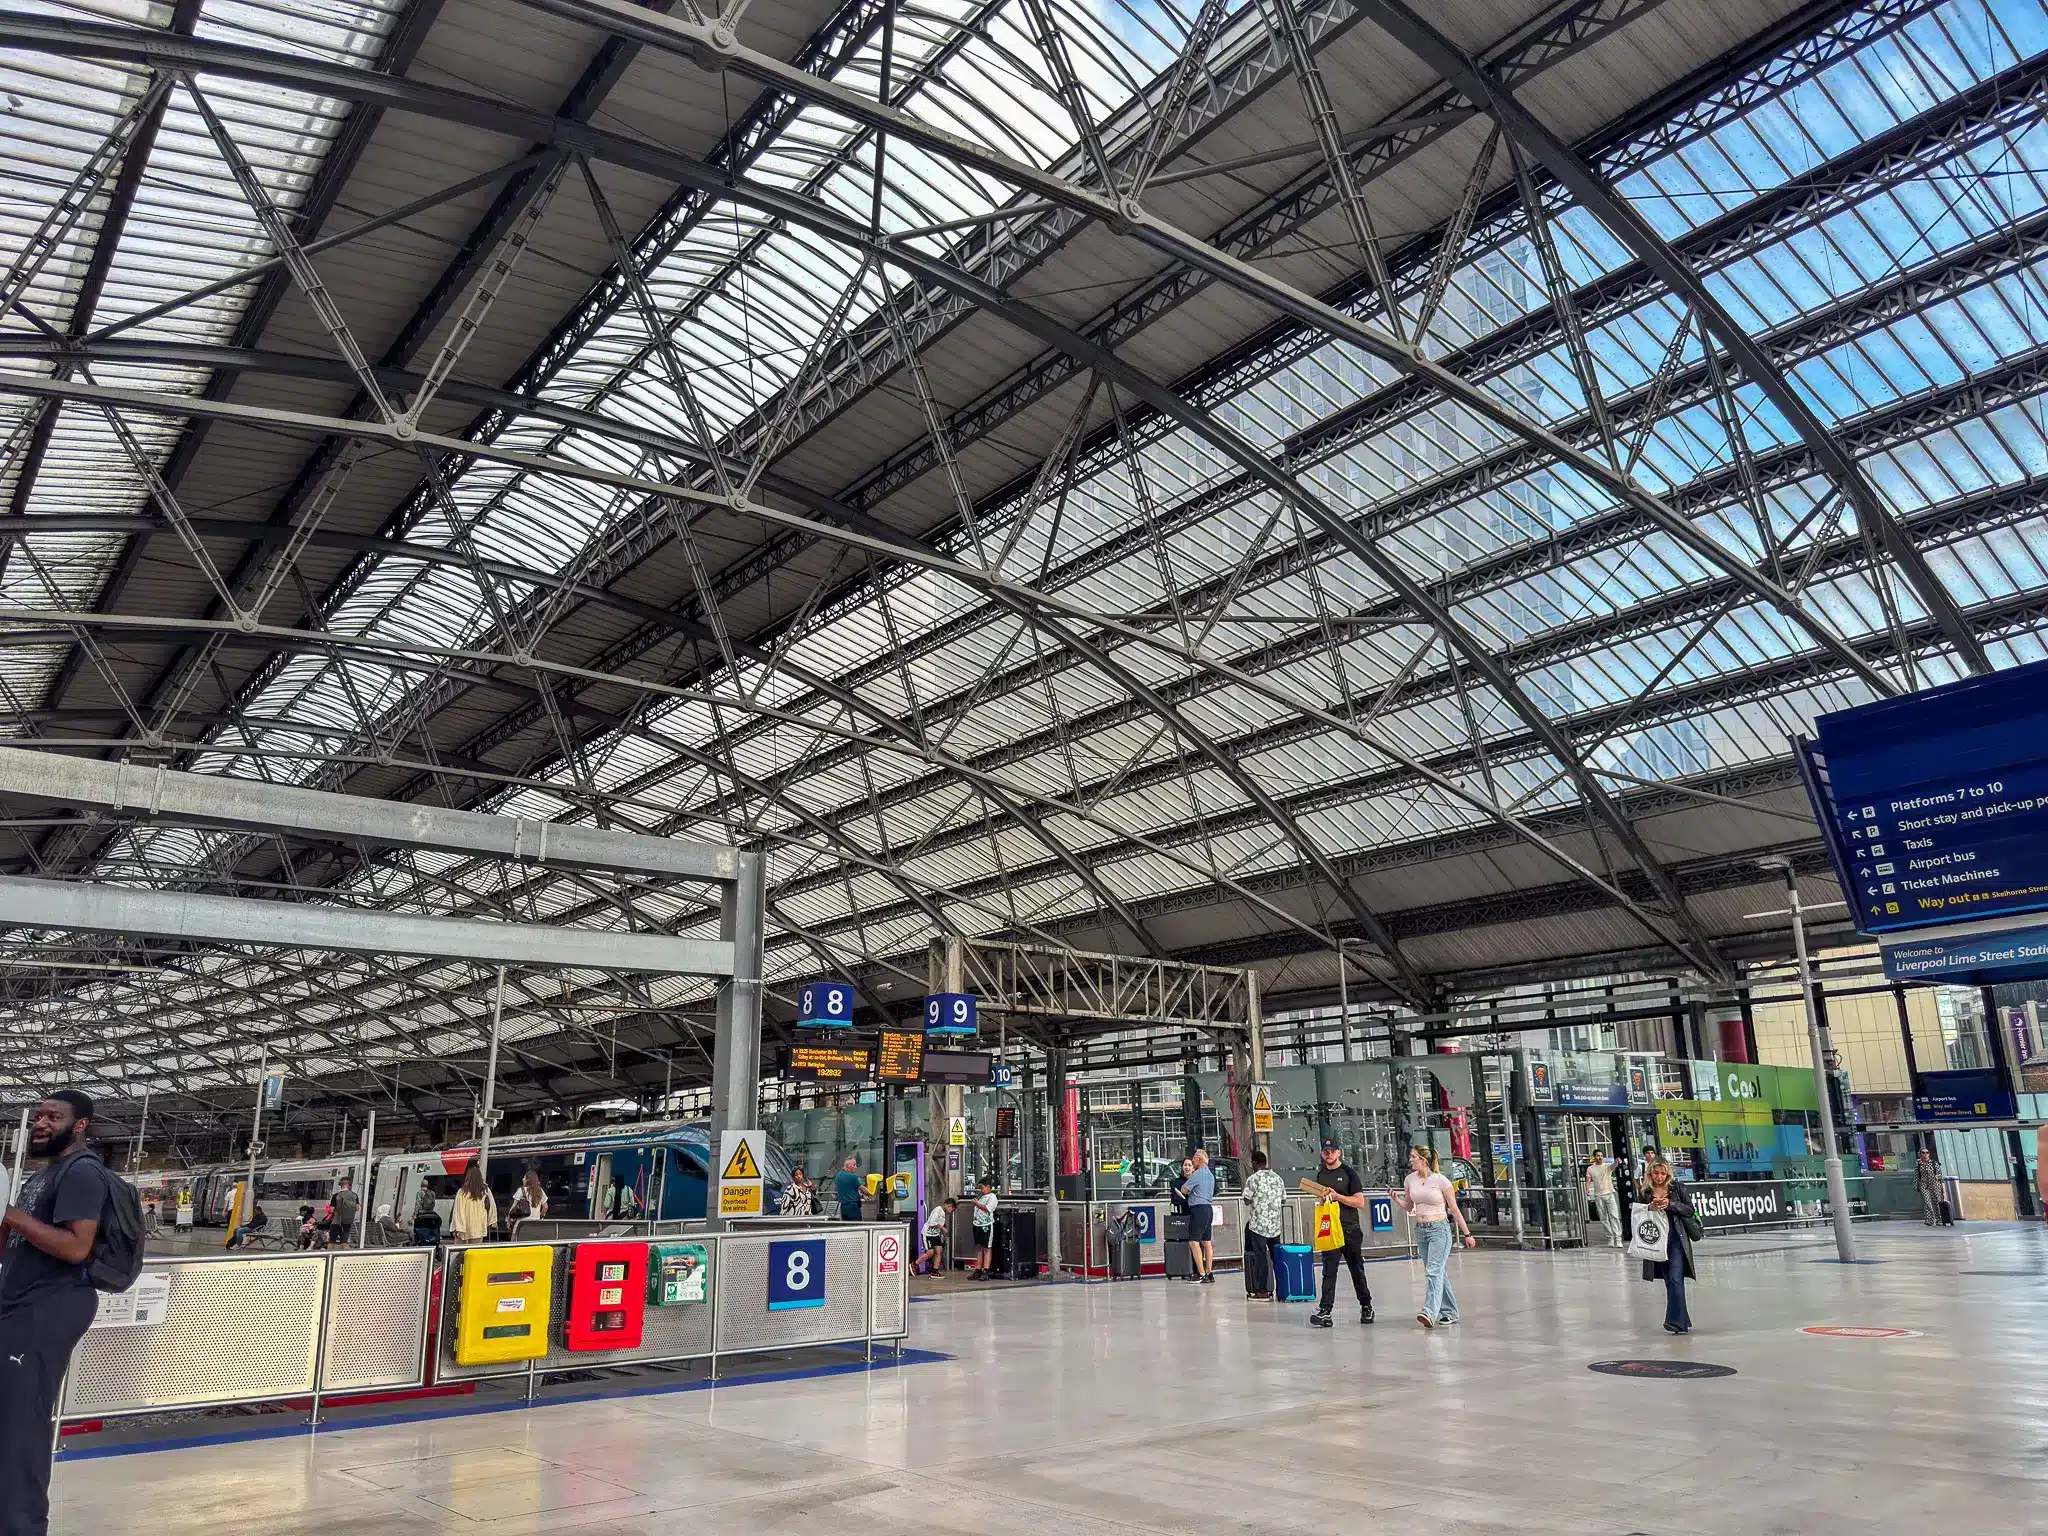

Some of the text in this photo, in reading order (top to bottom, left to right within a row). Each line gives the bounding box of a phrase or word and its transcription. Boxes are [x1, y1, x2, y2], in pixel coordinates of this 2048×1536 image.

[1890, 781, 2003, 813] Platforms 7 to 10
[1898, 817, 1932, 832] Short
[1933, 812, 1958, 825] stay
[1961, 806, 1983, 820] and
[1985, 799, 2033, 817] pick-up
[1903, 837, 1933, 851] Taxis
[1909, 851, 1976, 870] Airport bus
[1900, 868, 2000, 891] Ticket Machines
[1918, 897, 1945, 909] Way
[1948, 892, 1971, 905] out
[1991, 888, 2028, 899] Skelhorne
[1893, 946, 1944, 960] Welcome to
[1896, 944, 2048, 972] Liverpool Lime Street Stati
[803, 990, 812, 1015] 8
[827, 989, 843, 1015] 8
[929, 1001, 940, 1024] 9
[953, 1000, 968, 1023] 9
[2017, 1027, 2026, 1050] Premier
[997, 1068, 1010, 1082] 10
[1727, 1073, 1762, 1099] Cool
[723, 1187, 752, 1196] Danger
[1137, 1211, 1149, 1234] 9
[1374, 1203, 1390, 1223] 10
[786, 1250, 810, 1290] 8
